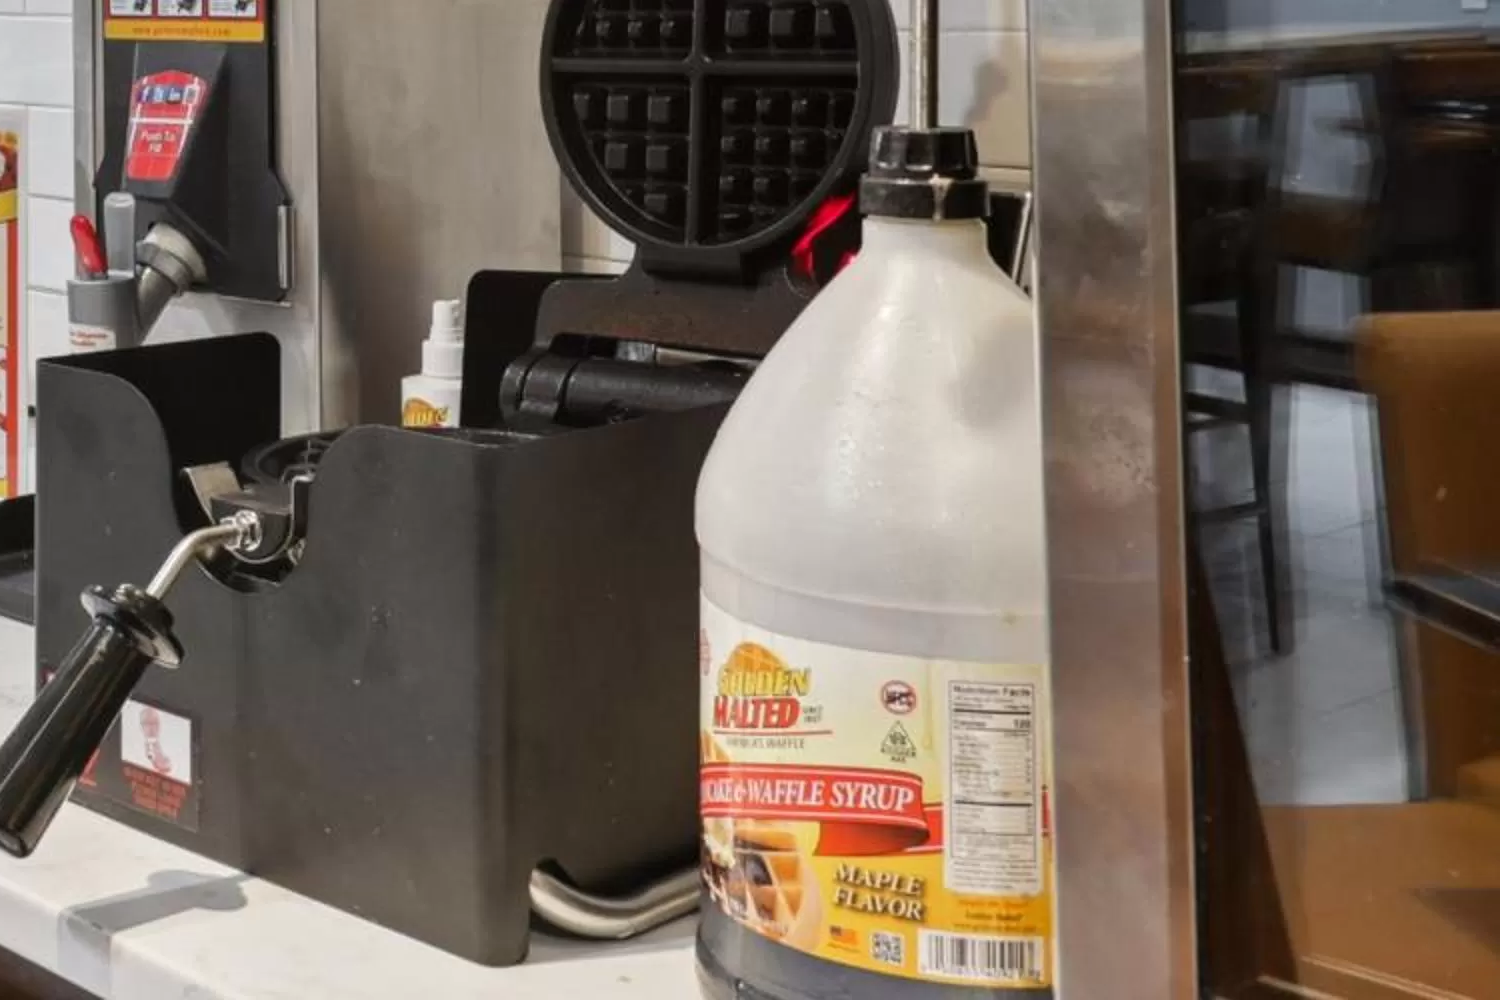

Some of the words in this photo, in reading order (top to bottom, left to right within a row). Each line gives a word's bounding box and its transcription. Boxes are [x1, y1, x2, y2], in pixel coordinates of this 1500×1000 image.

[718, 666, 812, 696] GOLDEN
[713, 696, 800, 729] MALTED
[746, 778, 826, 807] WAFFLE
[830, 780, 915, 812] SYRUP
[832, 863, 925, 897] MAPLE
[834, 887, 926, 922] FLAVOR
